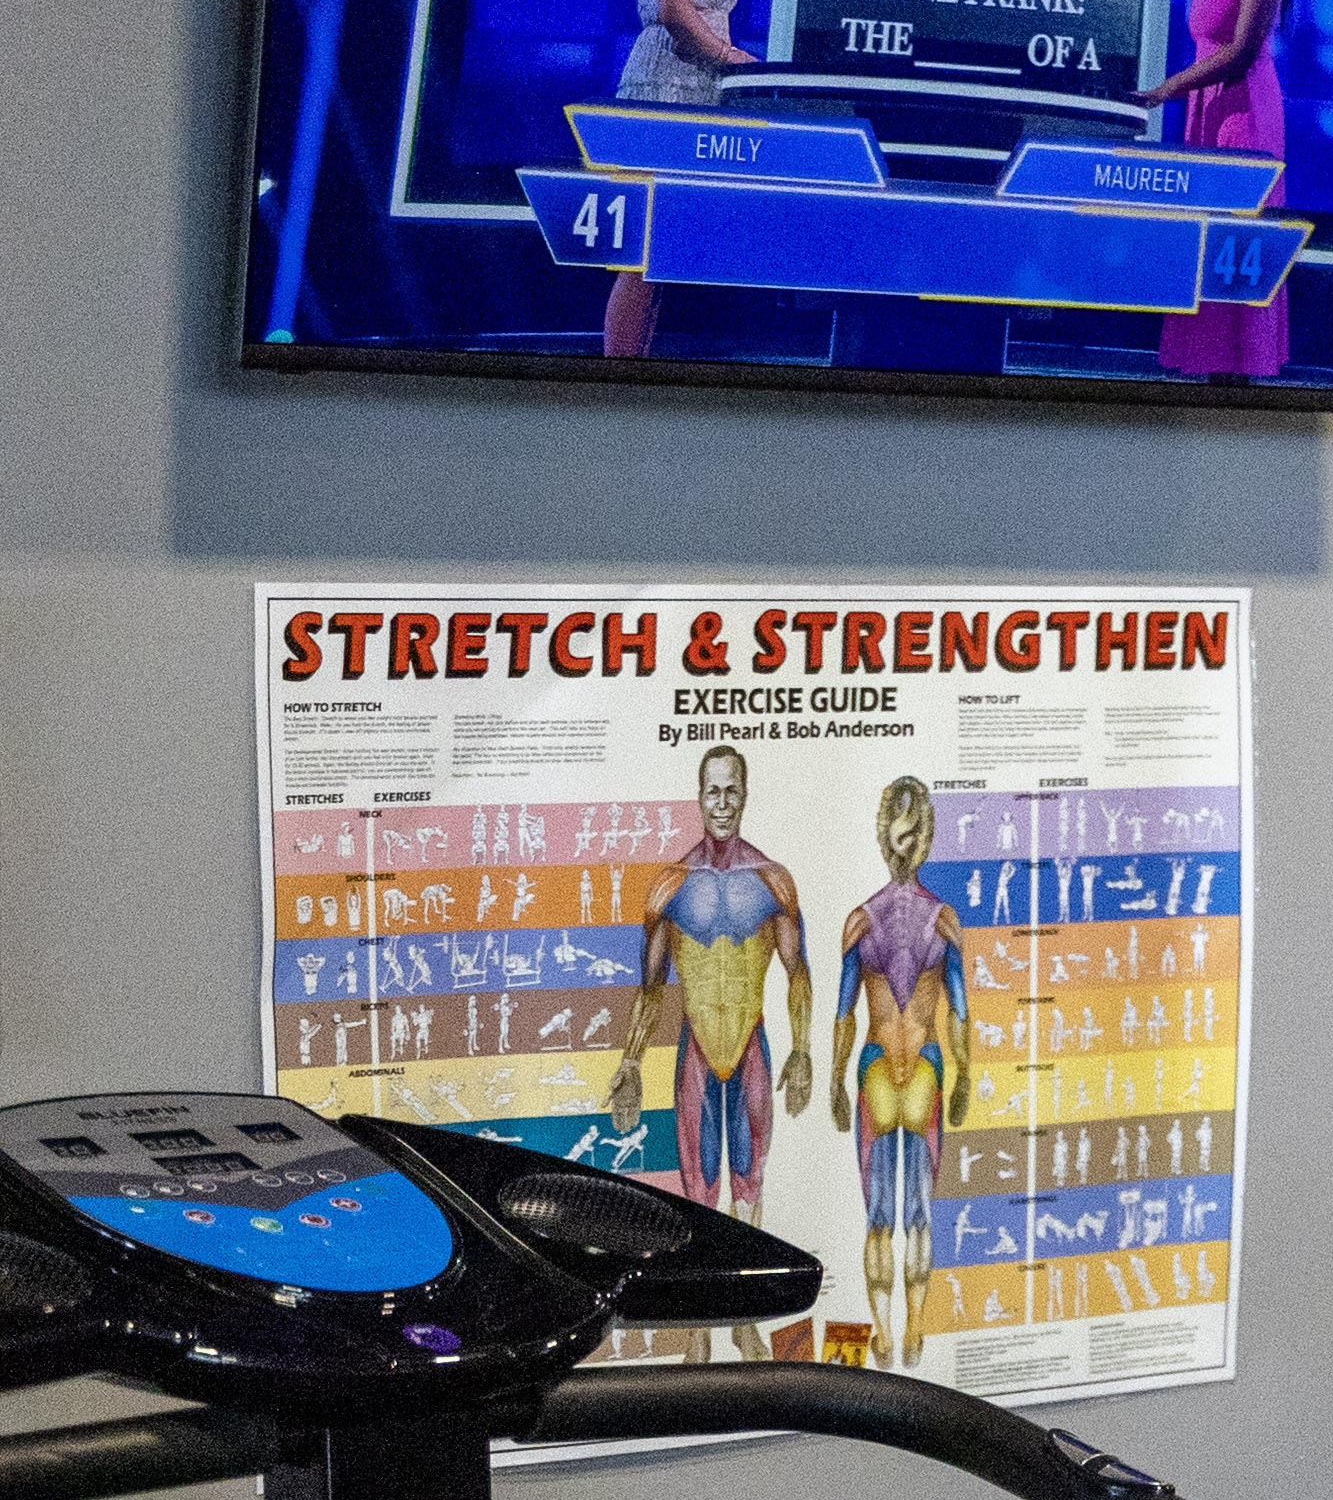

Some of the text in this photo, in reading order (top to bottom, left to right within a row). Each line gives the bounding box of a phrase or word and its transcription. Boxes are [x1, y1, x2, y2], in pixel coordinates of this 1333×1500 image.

[841, 16, 1101, 72] THE OF A
[695, 133, 763, 164] EMILY
[1093, 163, 1192, 194] MAUREEN
[572, 192, 628, 251] 41
[1212, 236, 1264, 287] 44
[283, 608, 1228, 682] STRETCH & STRENGTHEN
[283, 701, 382, 713] HOW TO STRETCH
[673, 687, 898, 716] EXERCISE GUIDE
[1000, 695, 1021, 705] LIFT
[658, 719, 915, 747] By Bill Pearl & Bob Anderson
[933, 779, 987, 791] STRETCHES
[285, 793, 345, 806] STRETCHES
[374, 791, 431, 803] EXERCISES
[359, 809, 383, 820] NECK
[345, 871, 397, 884] SHOULDERS
[348, 1066, 406, 1079] ABDOMINALS
